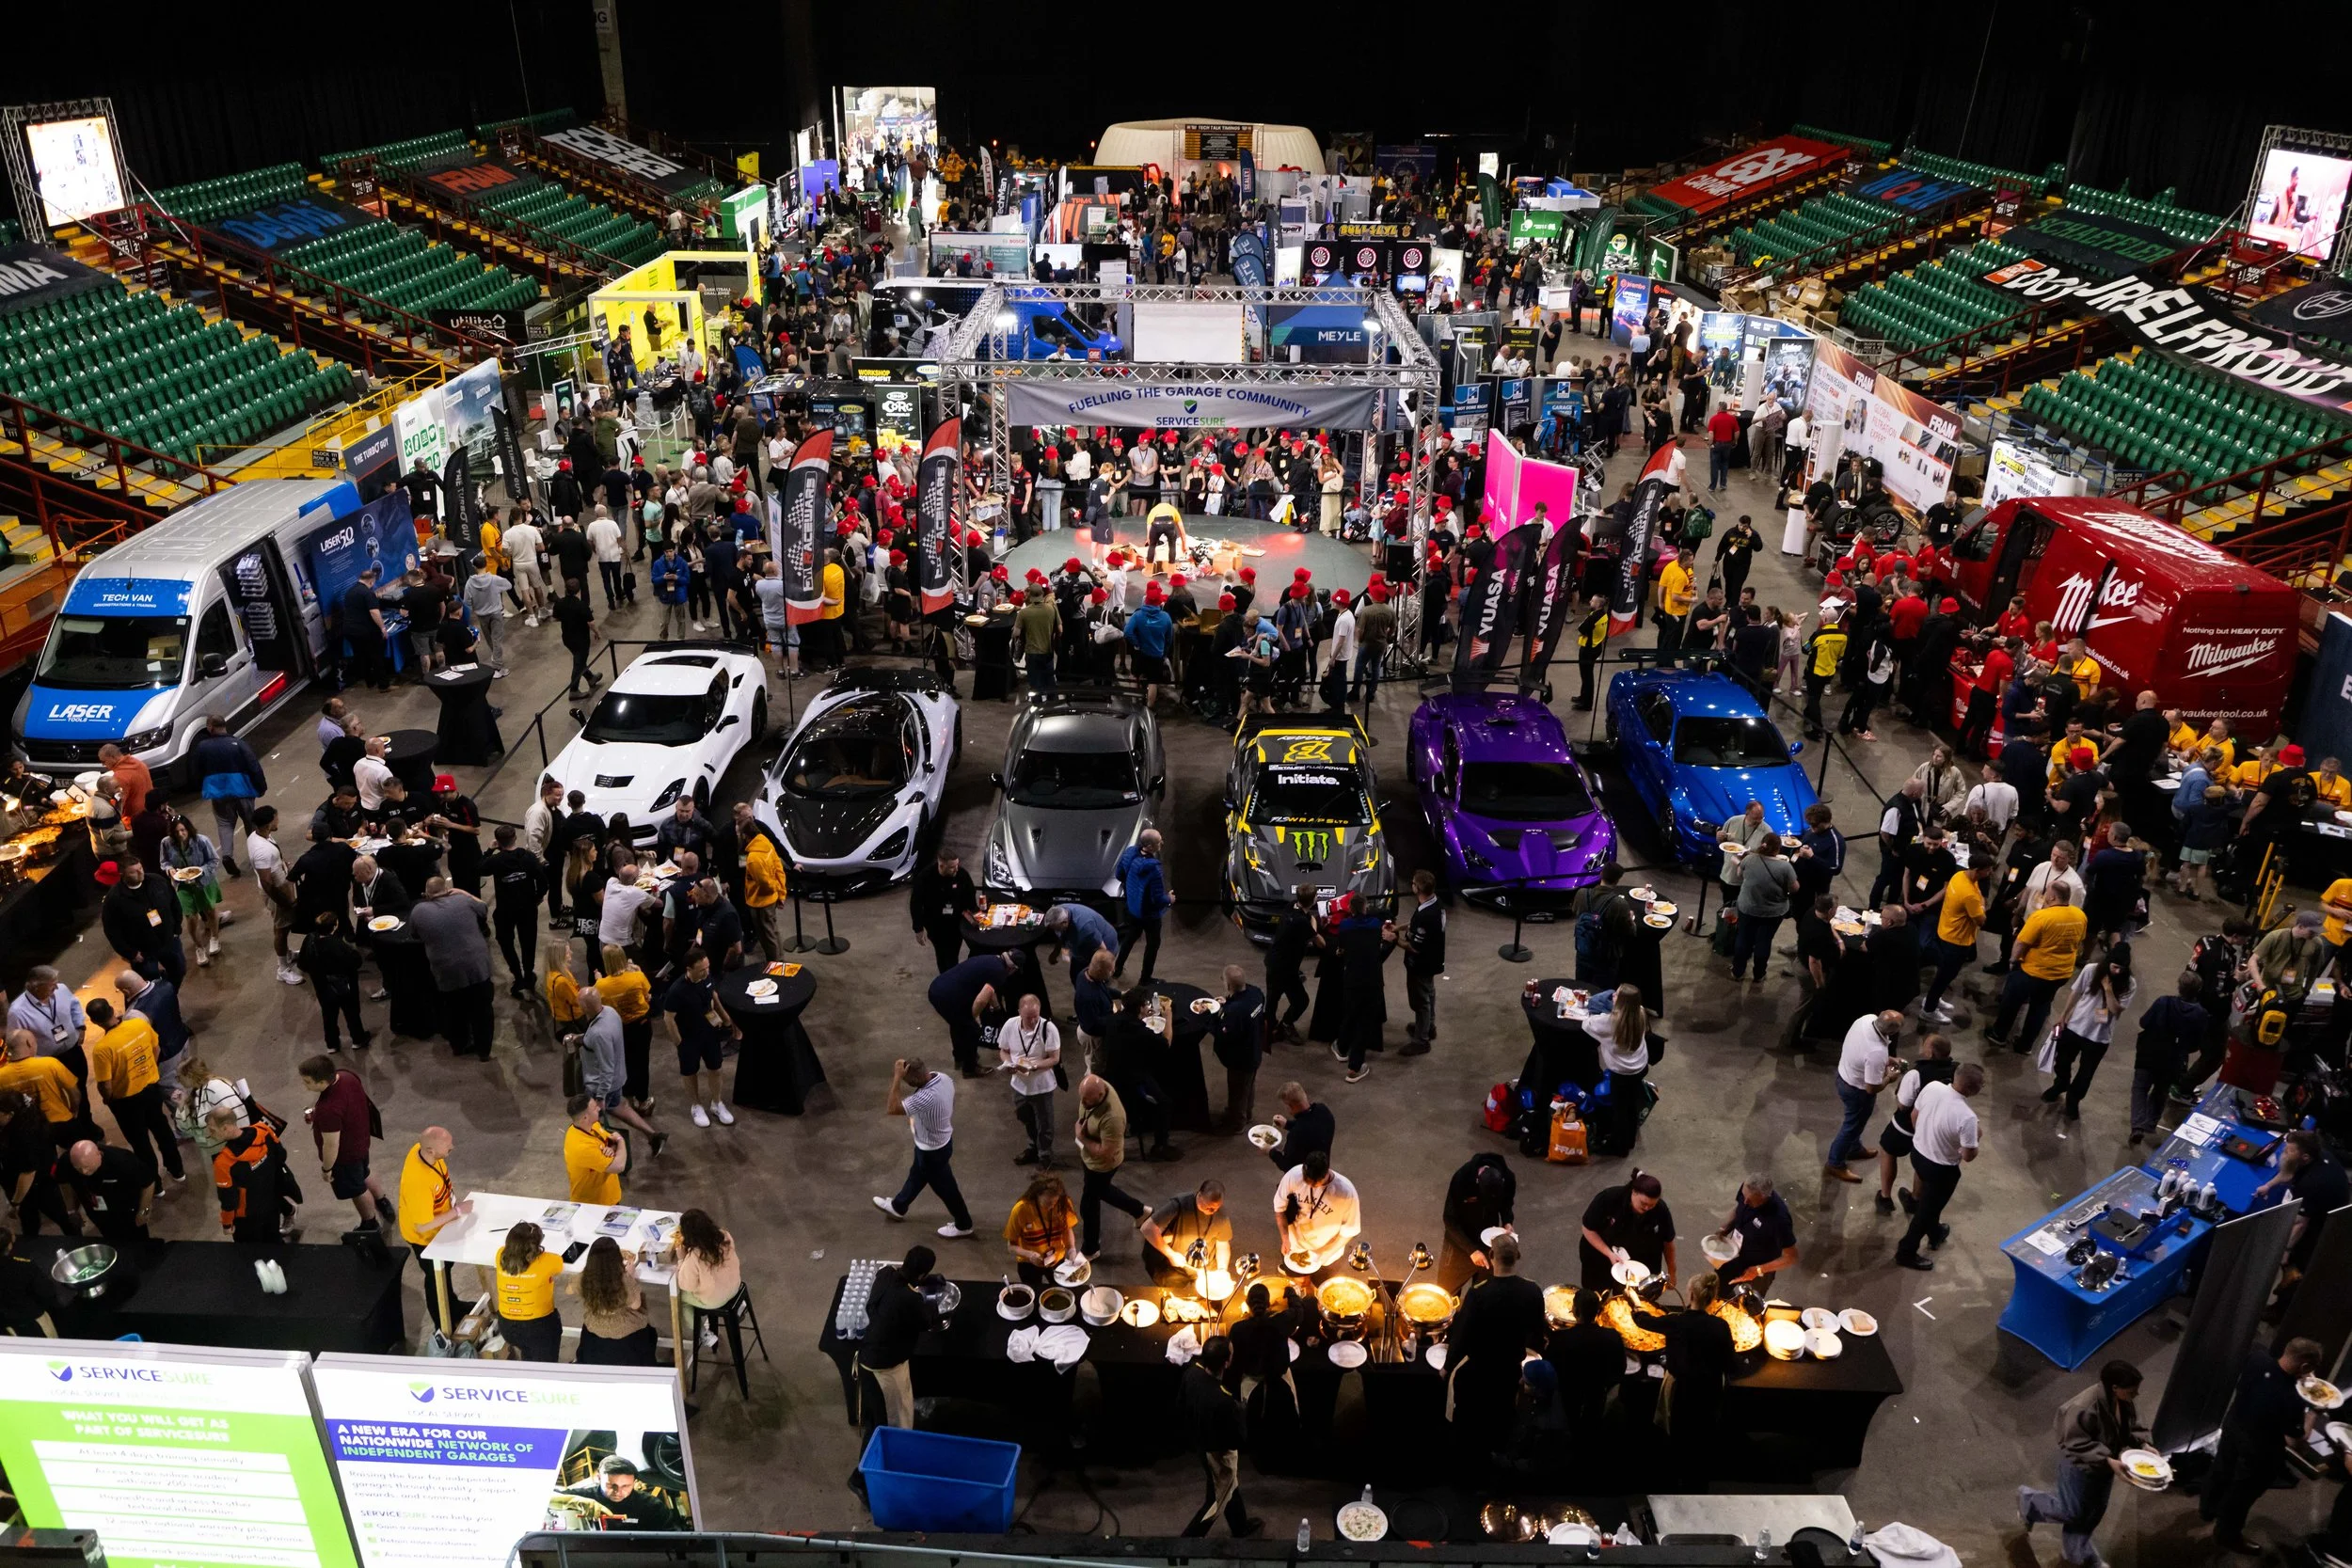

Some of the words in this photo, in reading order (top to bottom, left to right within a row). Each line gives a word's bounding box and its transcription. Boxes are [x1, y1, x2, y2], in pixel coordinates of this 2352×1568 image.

[996, 177, 1008, 216] echMan
[220, 199, 347, 248] Delphi
[2028, 217, 2176, 263] SCHAEFFLER
[450, 314, 492, 329] utilita
[1318, 331, 1361, 341] MEYLE
[1854, 371, 1874, 392] FRAM
[1069, 389, 1132, 414] FUELLING
[1136, 387, 1164, 399] THE
[1166, 387, 1223, 398] GARAGE
[1227, 388, 1311, 419] COMMUNITY
[1156, 417, 1226, 427] SERVICESURE
[1929, 414, 1957, 439] FRAM
[354, 452, 364, 467] THE
[364, 441, 380, 460] TURBO
[379, 436, 389, 450] GUY
[504, 441, 519, 478] TURBO
[457, 488, 468, 523] TURBO
[935, 466, 946, 554] RACEWARS
[803, 477, 817, 564] RACEWARS
[320, 535, 341, 553] LASER
[340, 527, 355, 548] 50
[461, 523, 471, 543] GUY
[133, 594, 153, 603] VAN
[1478, 568, 1507, 636] YUASA
[1537, 564, 1561, 634] YUASA
[2183, 627, 2215, 636] Nothing
[2184, 638, 2277, 670] Milwaukee
[49, 705, 115, 719] LASER
[577, 918, 599, 927] TECH
[80, 1366, 214, 1386] SERVICESURE
[442, 1386, 580, 1405] SERVICESURE
[61, 1410, 104, 1423] WHAT
[105, 1412, 138, 1424] YOU
[140, 1414, 175, 1426] WILL
[178, 1416, 204, 1429] GET
[210, 1418, 230, 1430] AS
[74, 1424, 110, 1436] PART
[114, 1426, 133, 1436] OF
[136, 1427, 230, 1443] SERVICESURE
[338, 1424, 349, 1434] A
[352, 1425, 387, 1436] NEW
[390, 1427, 421, 1438] ERA
[422, 1428, 452, 1439] FOR
[455, 1430, 487, 1441] OUR
[340, 1435, 435, 1449] NATIONWIDE
[437, 1440, 510, 1452] NETWORK
[515, 1443, 533, 1453] OF
[343, 1447, 442, 1460] INDEPENDENT
[447, 1450, 516, 1463] GARAGES
[445, 1475, 506, 1484] independent
[360, 1510, 427, 1520] SERVICESURE
